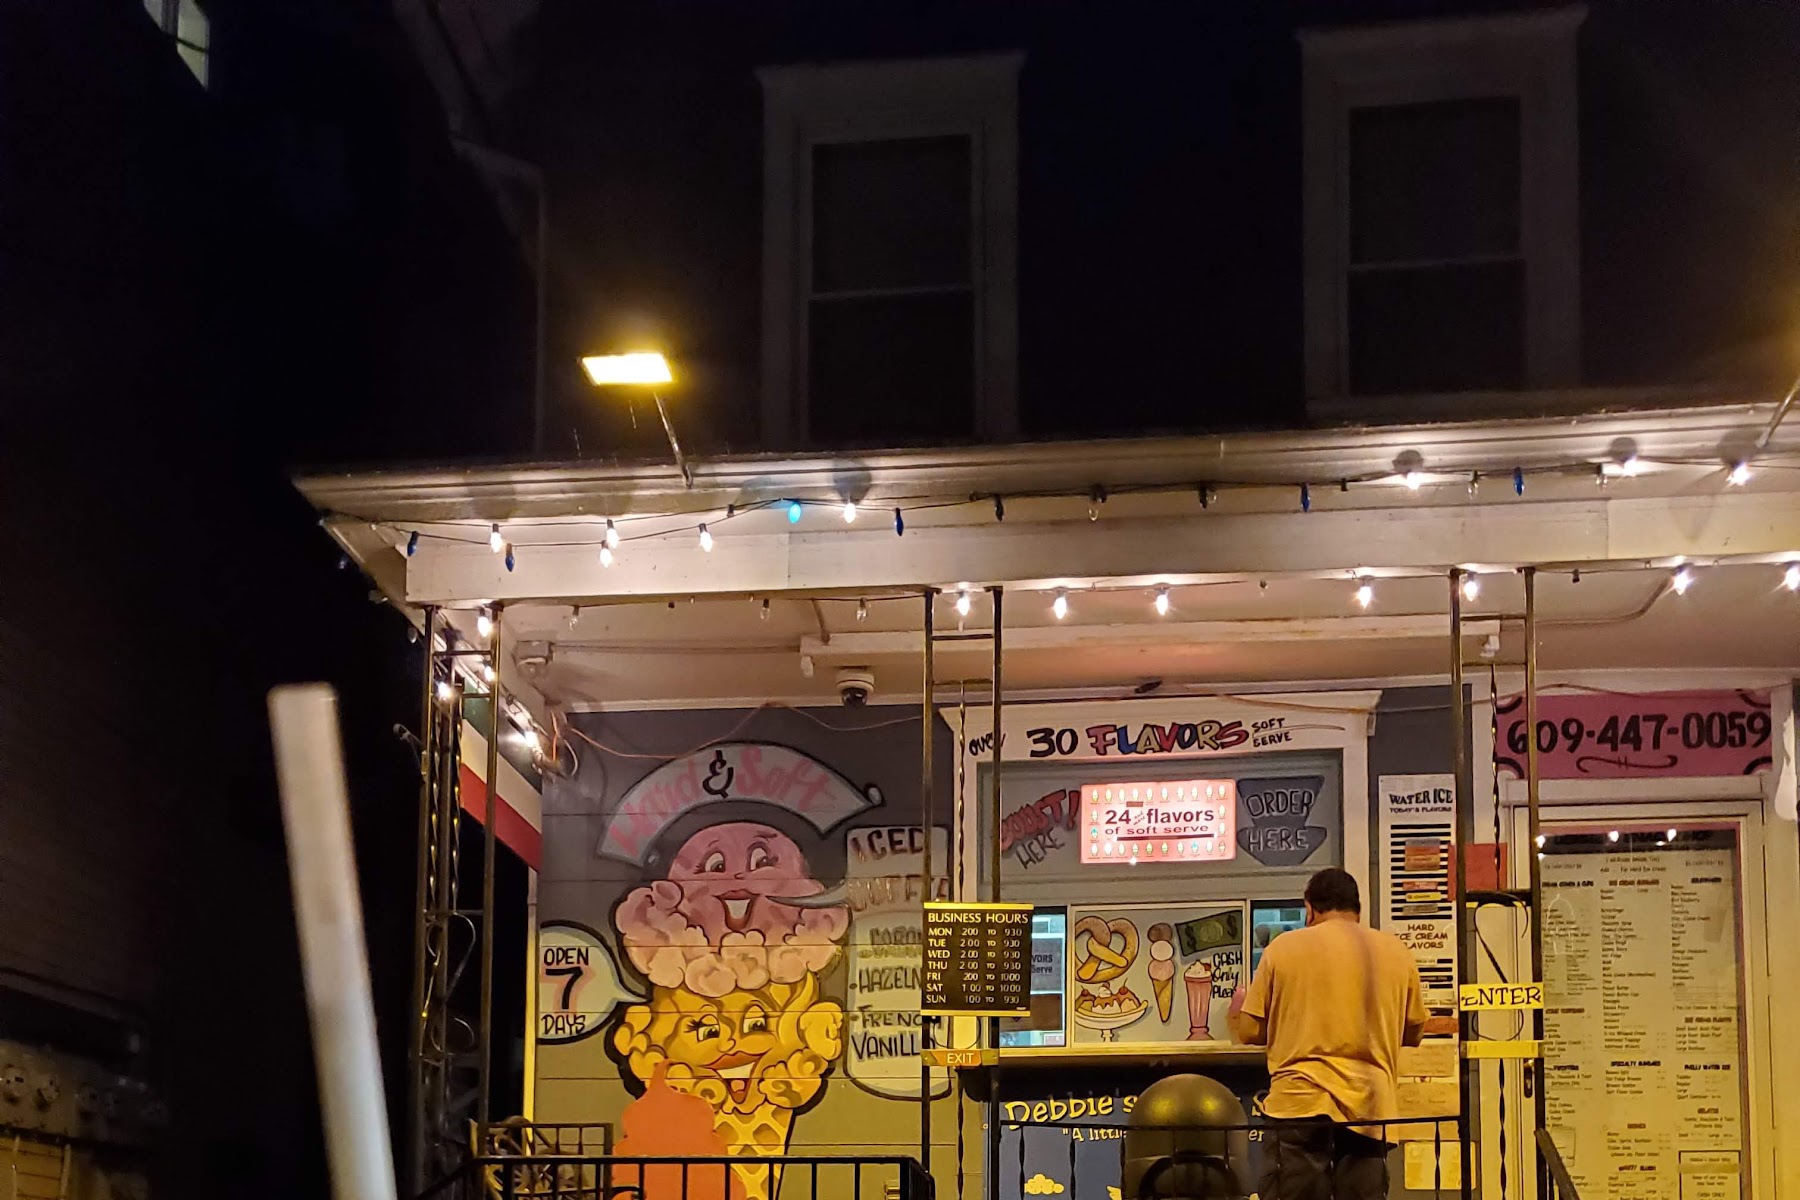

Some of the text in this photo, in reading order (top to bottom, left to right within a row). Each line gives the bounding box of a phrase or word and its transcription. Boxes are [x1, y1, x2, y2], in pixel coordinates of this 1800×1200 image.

[1251, 717, 1286, 733] SOFT
[1507, 711, 1771, 754] 609-447-0059
[1026, 727, 1079, 757] 30
[1086, 720, 1250, 756] FLAVORS
[1252, 732, 1292, 748] SERVE
[702, 749, 734, 798] &
[1246, 789, 1314, 818] ORDER
[1389, 788, 1453, 805] WATER ICE
[1105, 808, 1214, 825] 24 flavors
[1105, 825, 1209, 836] of soft serve
[851, 828, 924, 862] ICED
[1015, 827, 1066, 869] HERE
[1247, 827, 1309, 852] HERE
[927, 912, 1029, 924] BUSINESS HOURS
[927, 928, 953, 937] MON
[1394, 932, 1448, 941] CE CREAM
[928, 938, 947, 948] TUE
[543, 947, 589, 967] OPEN
[927, 949, 950, 959] WED
[1031, 954, 1053, 963] VORS
[1212, 950, 1243, 968] CASH
[927, 960, 948, 970] THU
[858, 966, 922, 994] HAZELN
[926, 972, 941, 981] FRI
[545, 966, 584, 1010] 7
[926, 983, 944, 992] SAT
[1212, 984, 1236, 998] Plea
[1461, 986, 1542, 1006] ENTER
[925, 994, 947, 1004] SUN
[541, 1014, 586, 1036] DAYS
[857, 1004, 941, 1029] FRENC
[947, 1053, 974, 1064] EXIT
